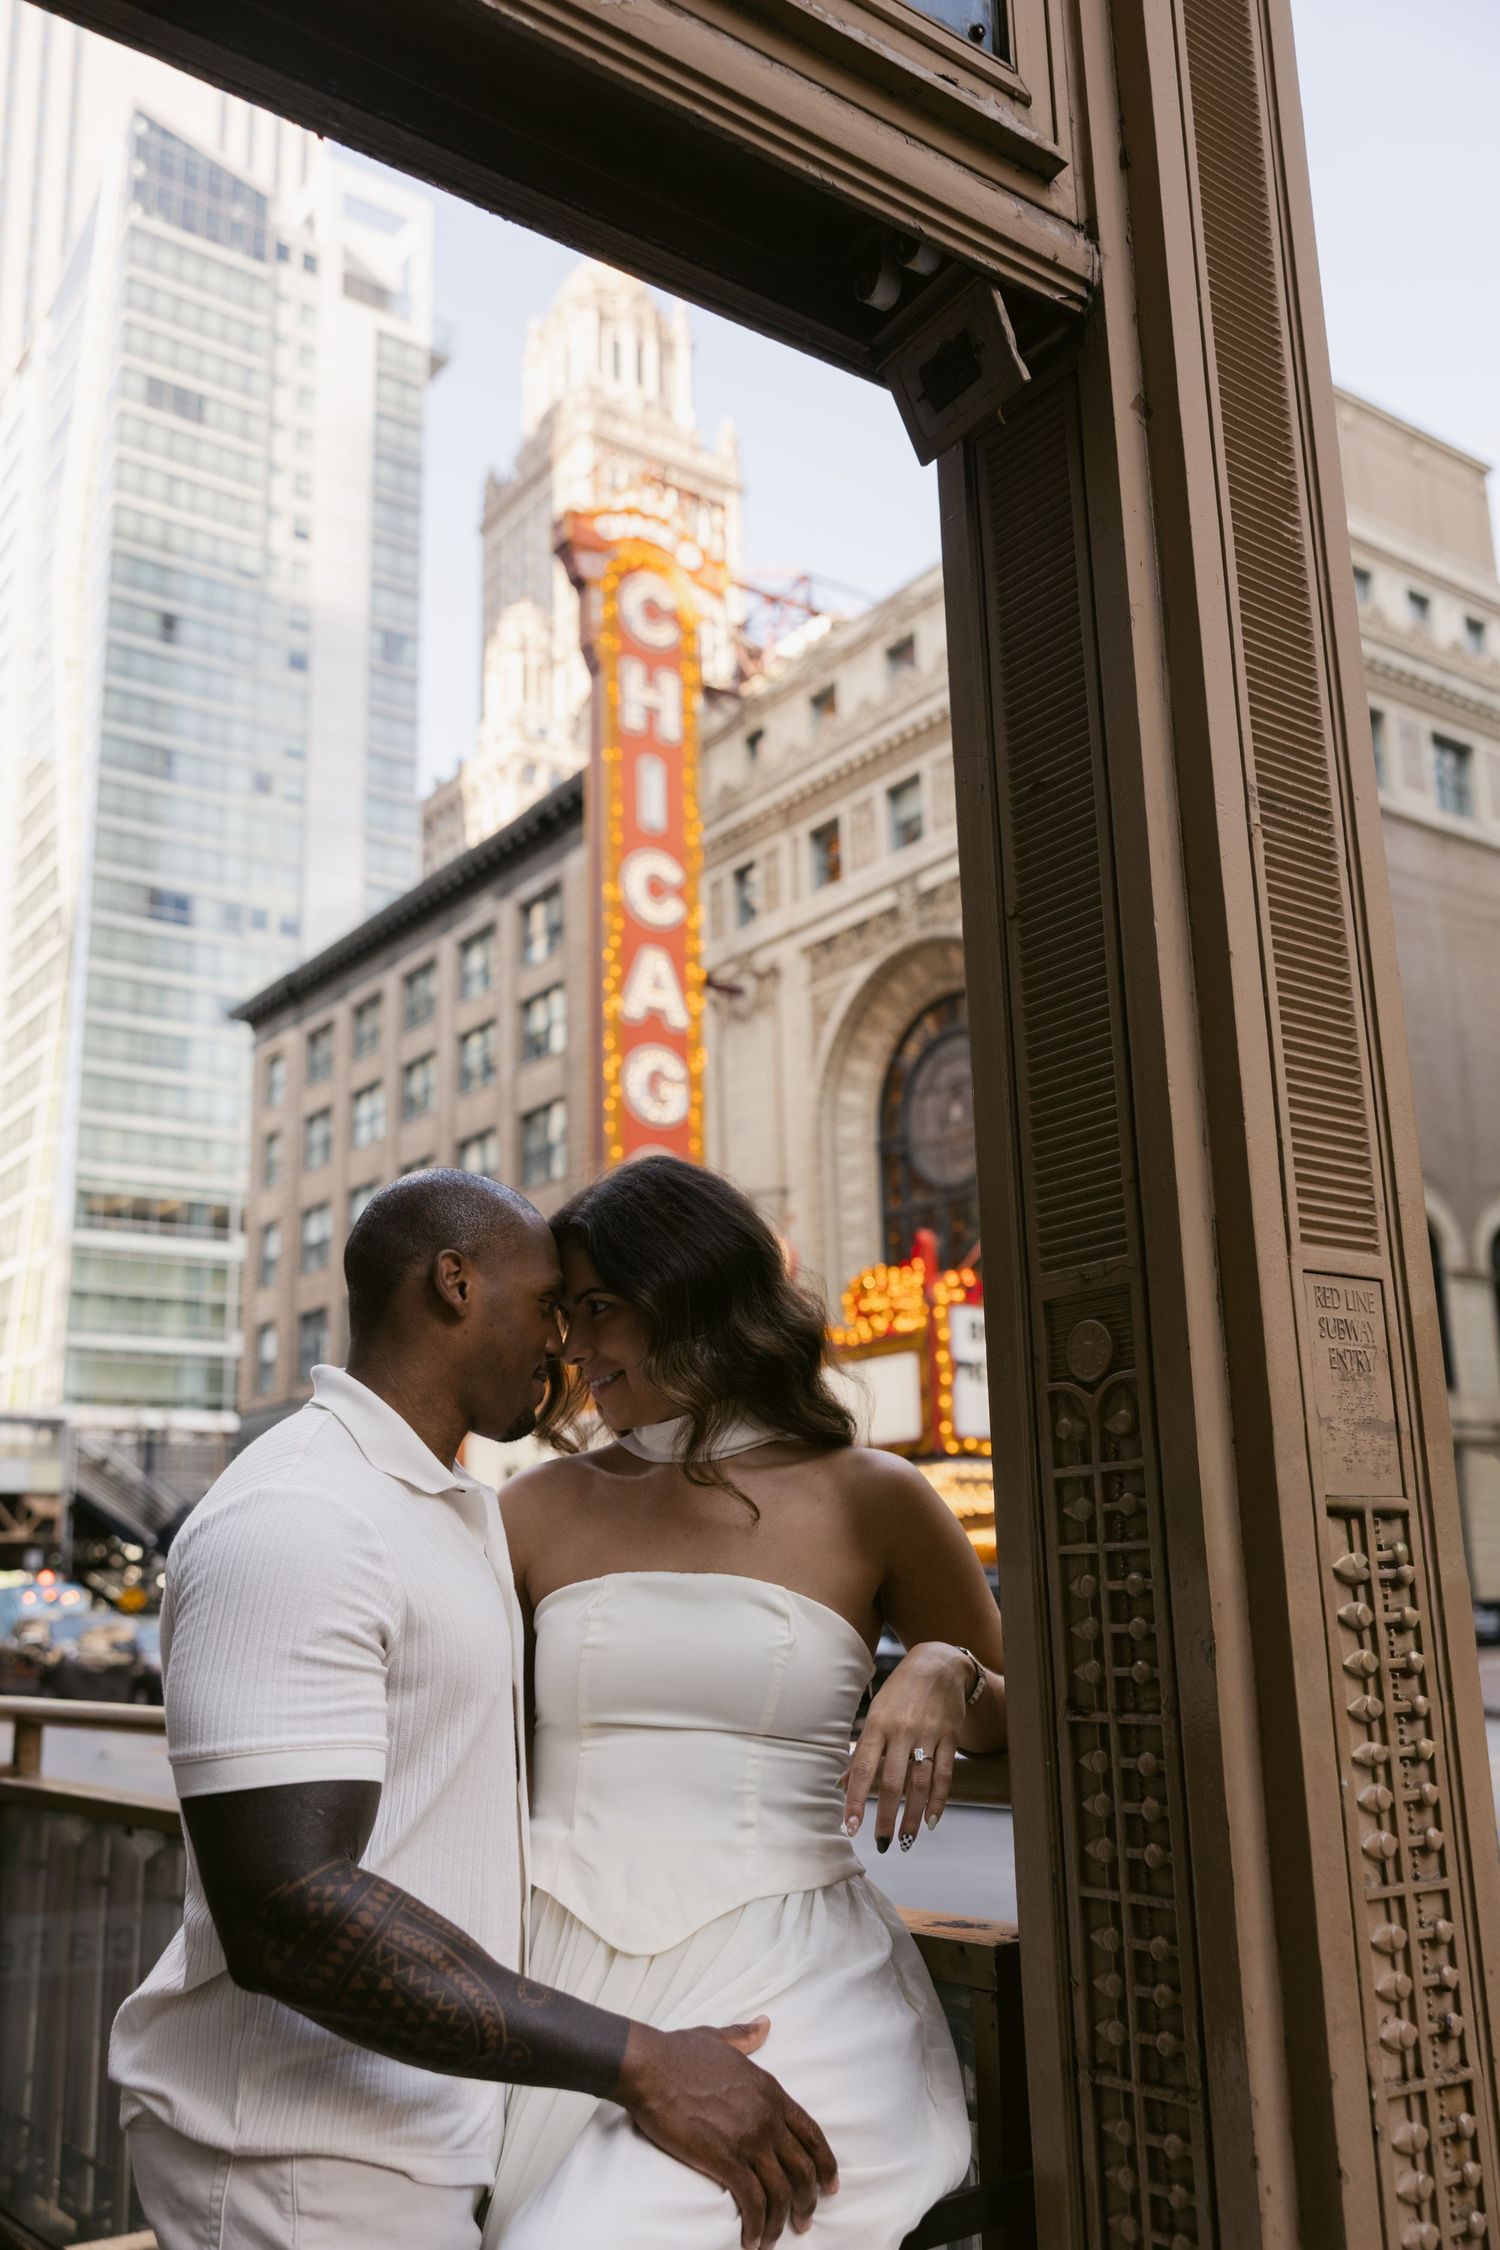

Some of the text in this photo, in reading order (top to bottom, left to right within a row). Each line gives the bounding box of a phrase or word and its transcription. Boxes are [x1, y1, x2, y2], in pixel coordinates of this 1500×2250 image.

[618, 568, 691, 1160] CHICAG
[1313, 1285, 1375, 1314] RED LINE
[1318, 1316, 1376, 1343] SUBWAY
[1328, 1347, 1376, 1373] ENTRY
